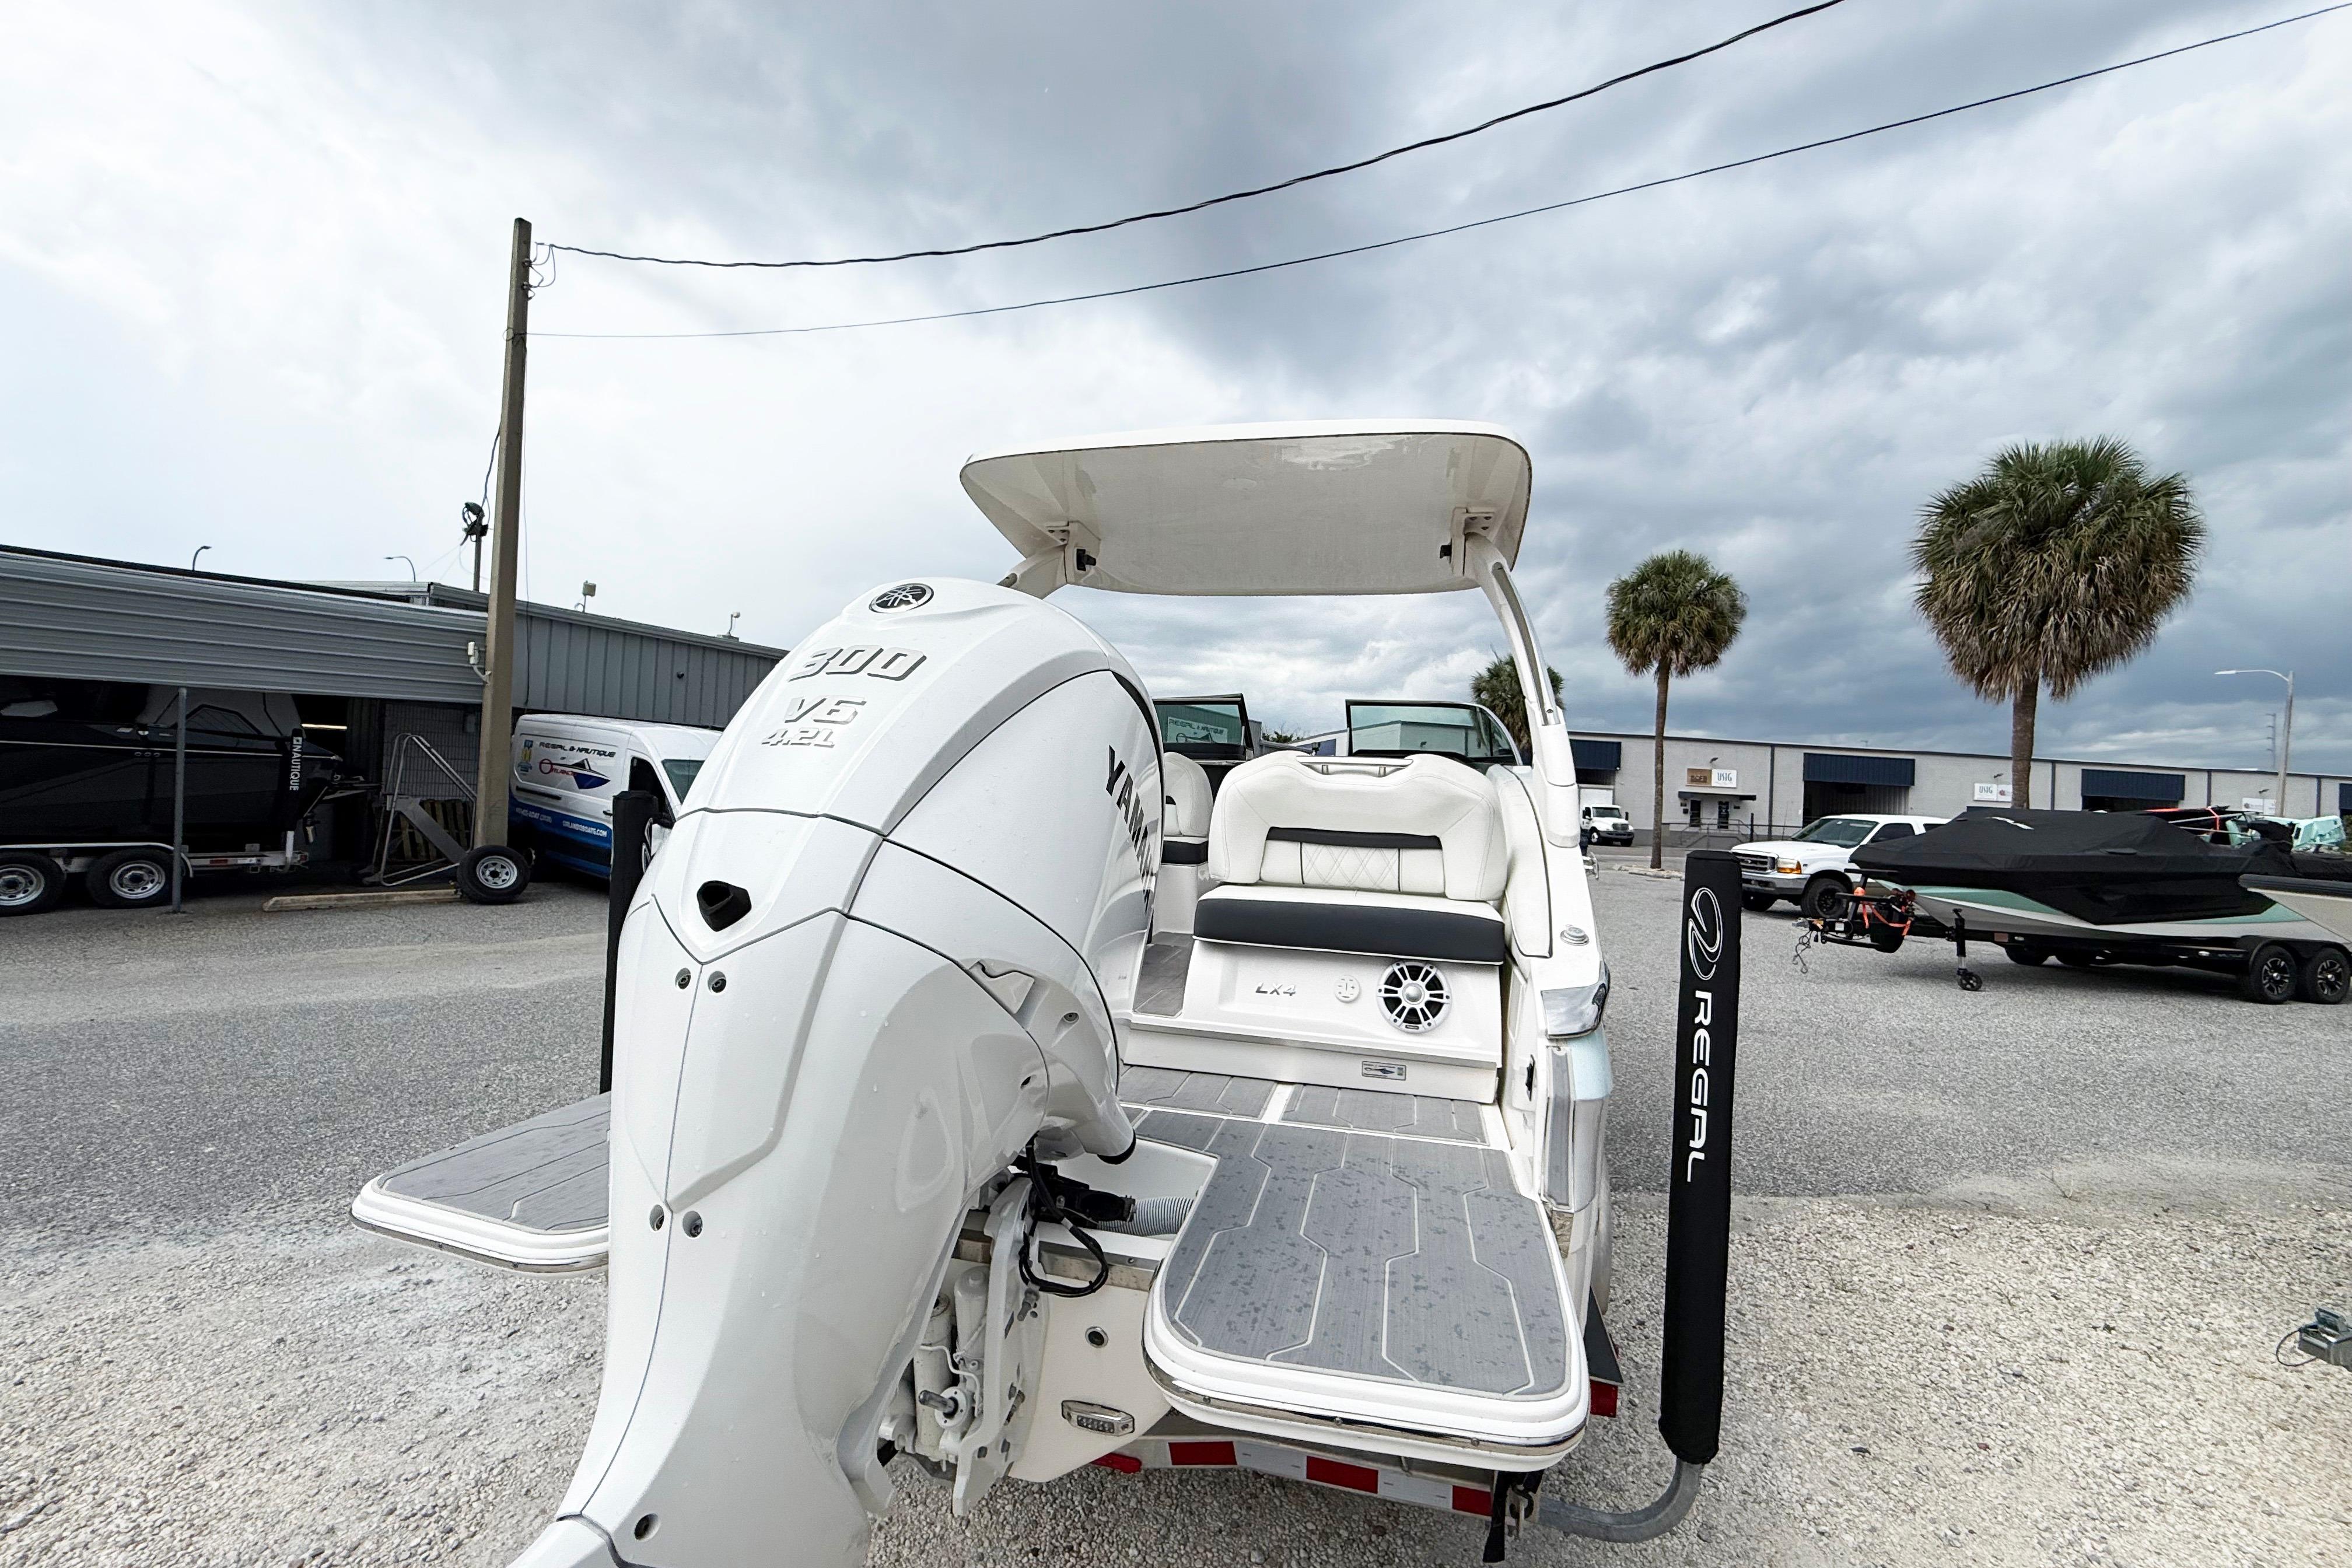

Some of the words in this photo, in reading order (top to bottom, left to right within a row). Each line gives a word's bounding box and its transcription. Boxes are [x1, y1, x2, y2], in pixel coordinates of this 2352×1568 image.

[787, 645, 928, 682] 300
[784, 695, 867, 725] V6
[539, 741, 569, 751] REGAL
[576, 747, 616, 757] NAUTIQUE
[289, 745, 302, 790] NAUTIQUE
[1255, 981, 1296, 996] LX4
[1686, 990, 1713, 1182] REGAL
